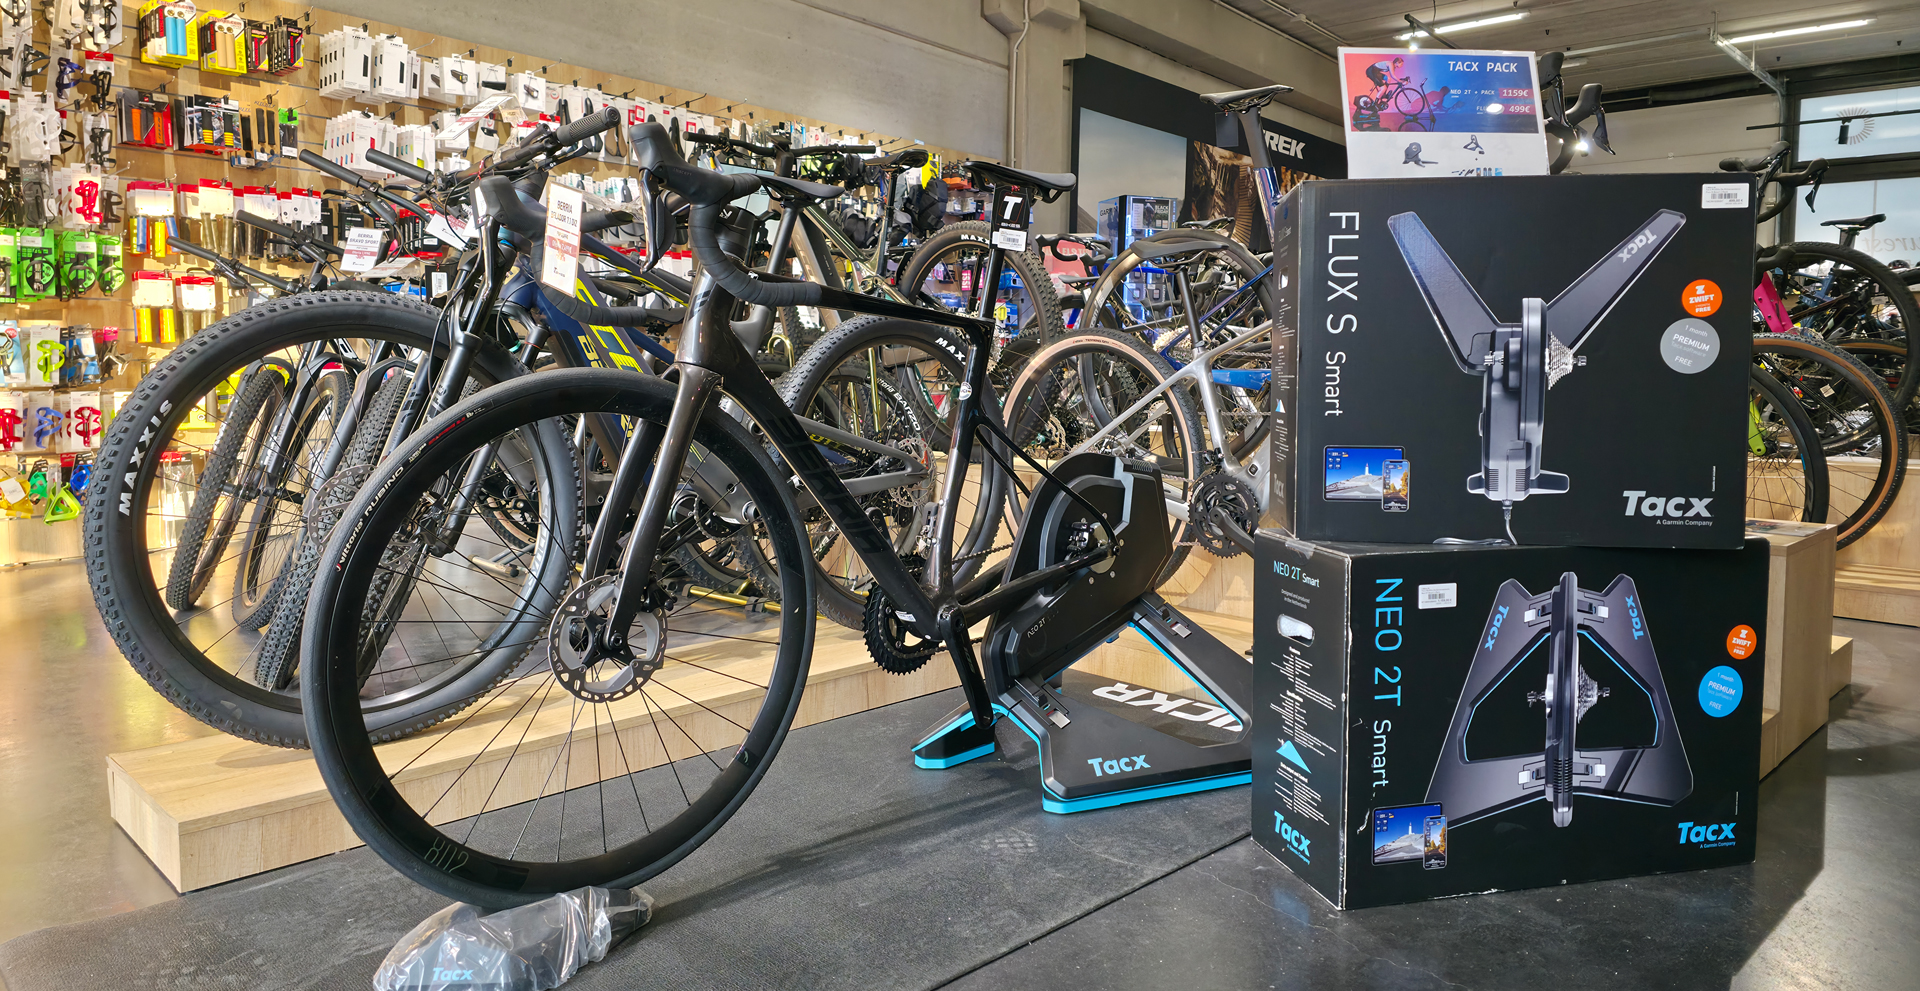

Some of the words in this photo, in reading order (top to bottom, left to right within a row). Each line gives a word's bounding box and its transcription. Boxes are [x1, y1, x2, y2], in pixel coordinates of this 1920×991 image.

[1448, 61, 1479, 72] TACX
[1486, 62, 1518, 73] PACK
[1502, 89, 1529, 97] 1159€
[1509, 105, 1530, 113] 499€
[1263, 129, 1306, 159] REK
[1327, 212, 1360, 302] FLUX
[1617, 229, 1658, 263] Tacx
[1688, 294, 1714, 304] ZWIFT
[1326, 313, 1358, 334] S
[1689, 327, 1708, 337] month
[1672, 333, 1710, 352] PREMIUM
[1674, 355, 1693, 366] FREE
[1325, 351, 1346, 416] Smart
[894, 392, 920, 431] BARZO
[118, 400, 173, 516] MAXXIS
[364, 466, 404, 517] RUBINO
[1622, 490, 1712, 517] Tacx
[1274, 560, 1289, 577] NEO
[1291, 566, 1301, 580] 2T
[1302, 572, 1320, 588] Smart
[1375, 578, 1403, 652] NEO
[1484, 604, 1509, 651] Tacx
[1625, 595, 1644, 640] Tacx
[1732, 637, 1752, 647] ZWIFT
[1374, 666, 1402, 706] 2T
[1708, 680, 1736, 696] PREMIUM
[1709, 700, 1722, 710] FREE
[1087, 754, 1151, 777] Tacx
[1372, 719, 1392, 788] Smart
[1274, 810, 1311, 857] Tacx
[1678, 822, 1736, 844] Tacx
[433, 967, 474, 981] Tacx
